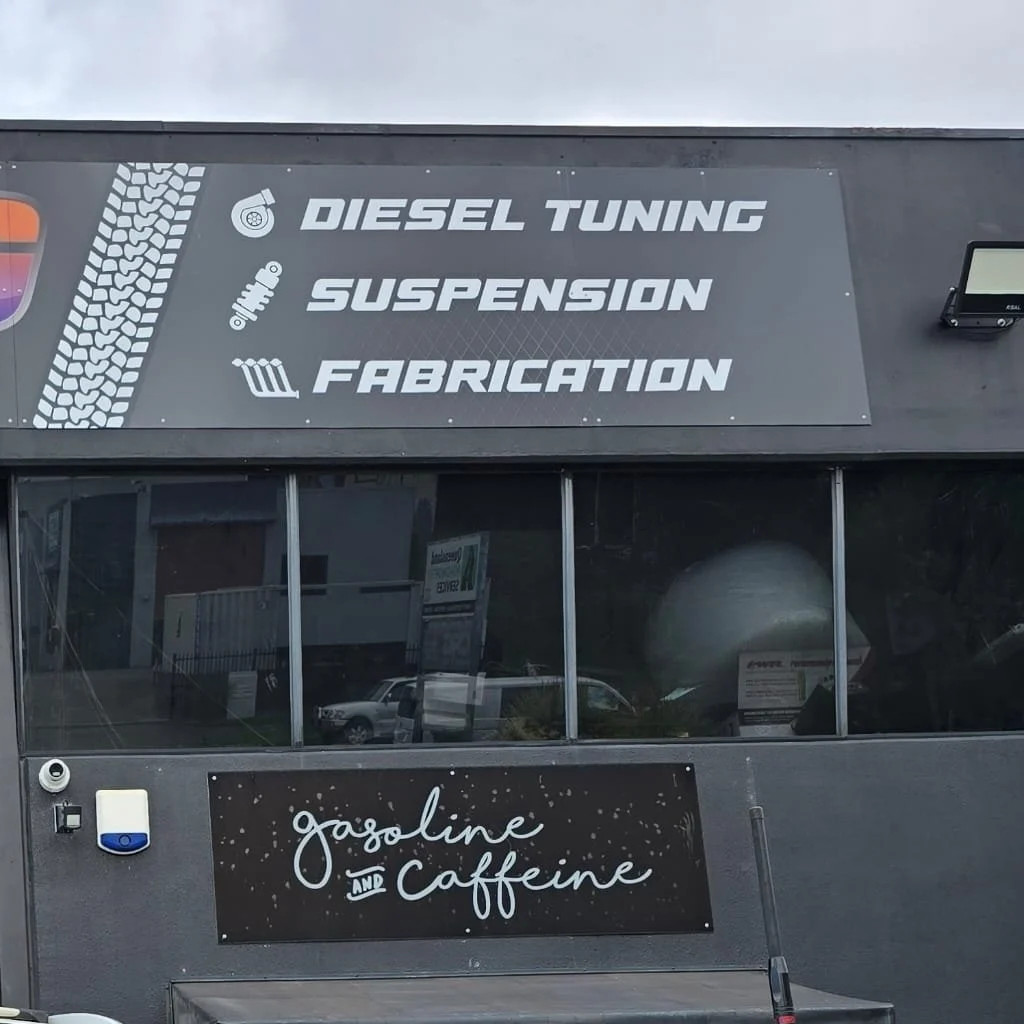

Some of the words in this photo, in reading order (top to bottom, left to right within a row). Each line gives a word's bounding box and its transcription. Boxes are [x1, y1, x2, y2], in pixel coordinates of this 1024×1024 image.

[299, 198, 525, 231] DIESEL
[544, 199, 768, 233] TUNING
[306, 278, 713, 312] SUSPENSION
[312, 358, 733, 394] FABRICATION
[292, 786, 544, 889] gasoline
[352, 873, 382, 894] AND
